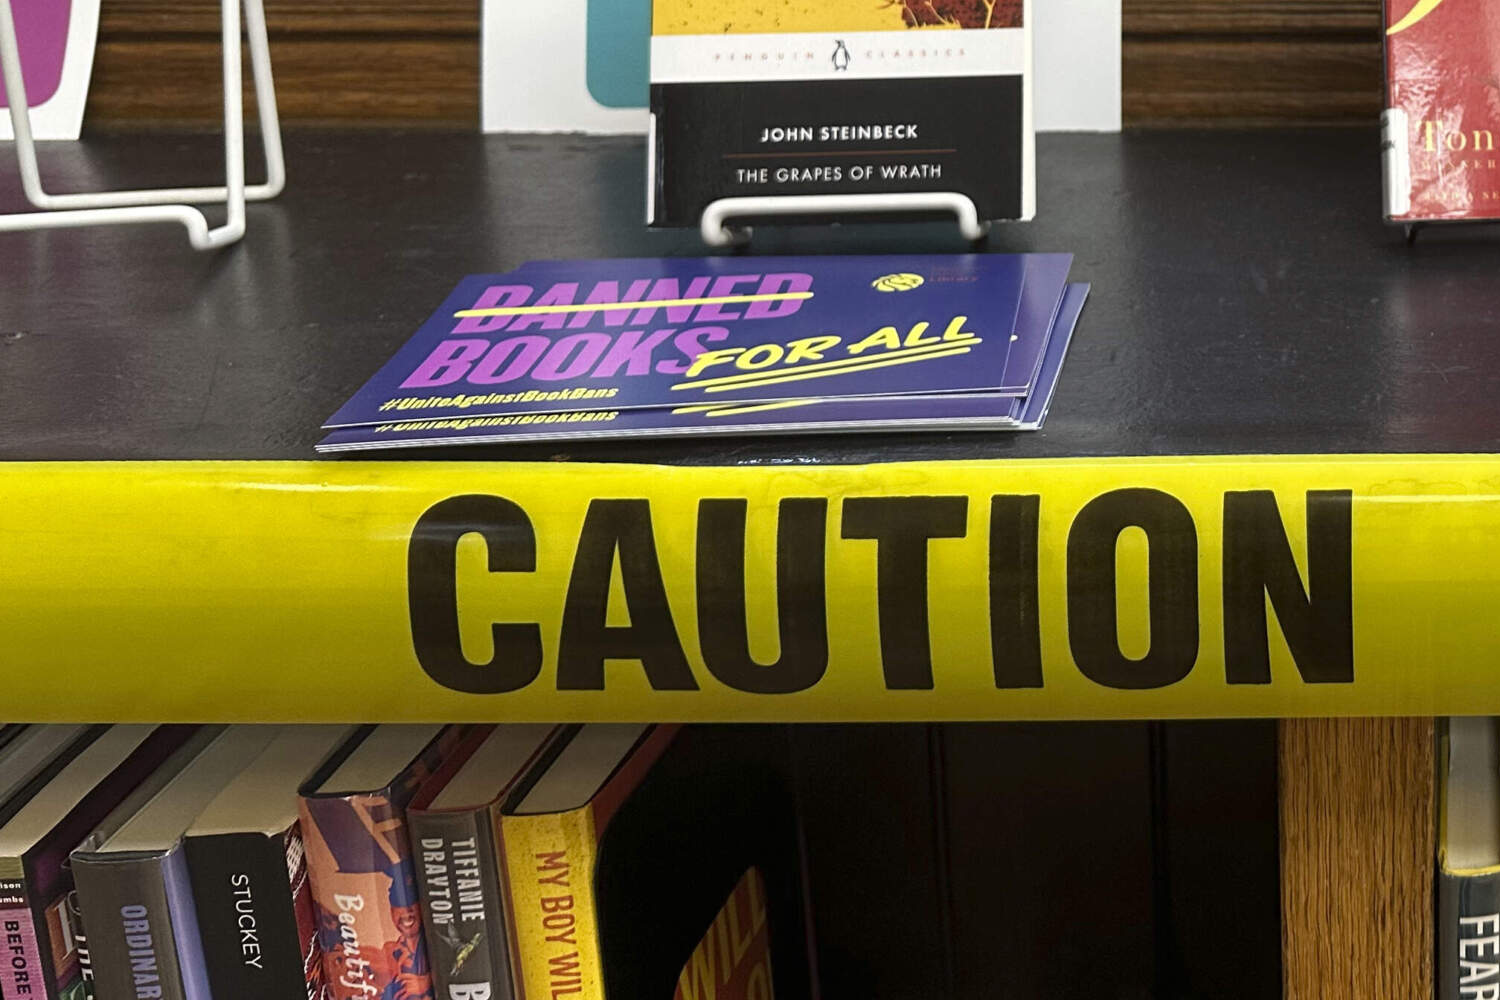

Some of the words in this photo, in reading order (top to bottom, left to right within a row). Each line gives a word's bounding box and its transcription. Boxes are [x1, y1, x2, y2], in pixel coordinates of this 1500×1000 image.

[715, 51, 814, 61] PENGUIN
[866, 48, 966, 59] CLASSICS
[761, 126, 813, 143] JOHN
[821, 124, 918, 141] STEINBECK
[737, 168, 768, 184] THE
[776, 166, 842, 183] GRAPES
[851, 165, 874, 181] OF
[880, 164, 942, 180] WRATH
[451, 272, 814, 335] BANNED
[399, 325, 731, 389] BOOKS
[686, 335, 841, 378] FOR
[847, 316, 976, 355] ALL
[378, 388, 619, 412] #UniteAgainstBookBans
[407, 489, 1356, 694] CAUTION
[421, 838, 454, 925] DRAYTON
[451, 837, 486, 922] TIFFANIE
[536, 851, 571, 887] MY
[231, 874, 263, 969] STUCKEY
[540, 895, 577, 945] BOY
[5, 920, 32, 995] BEFORE
